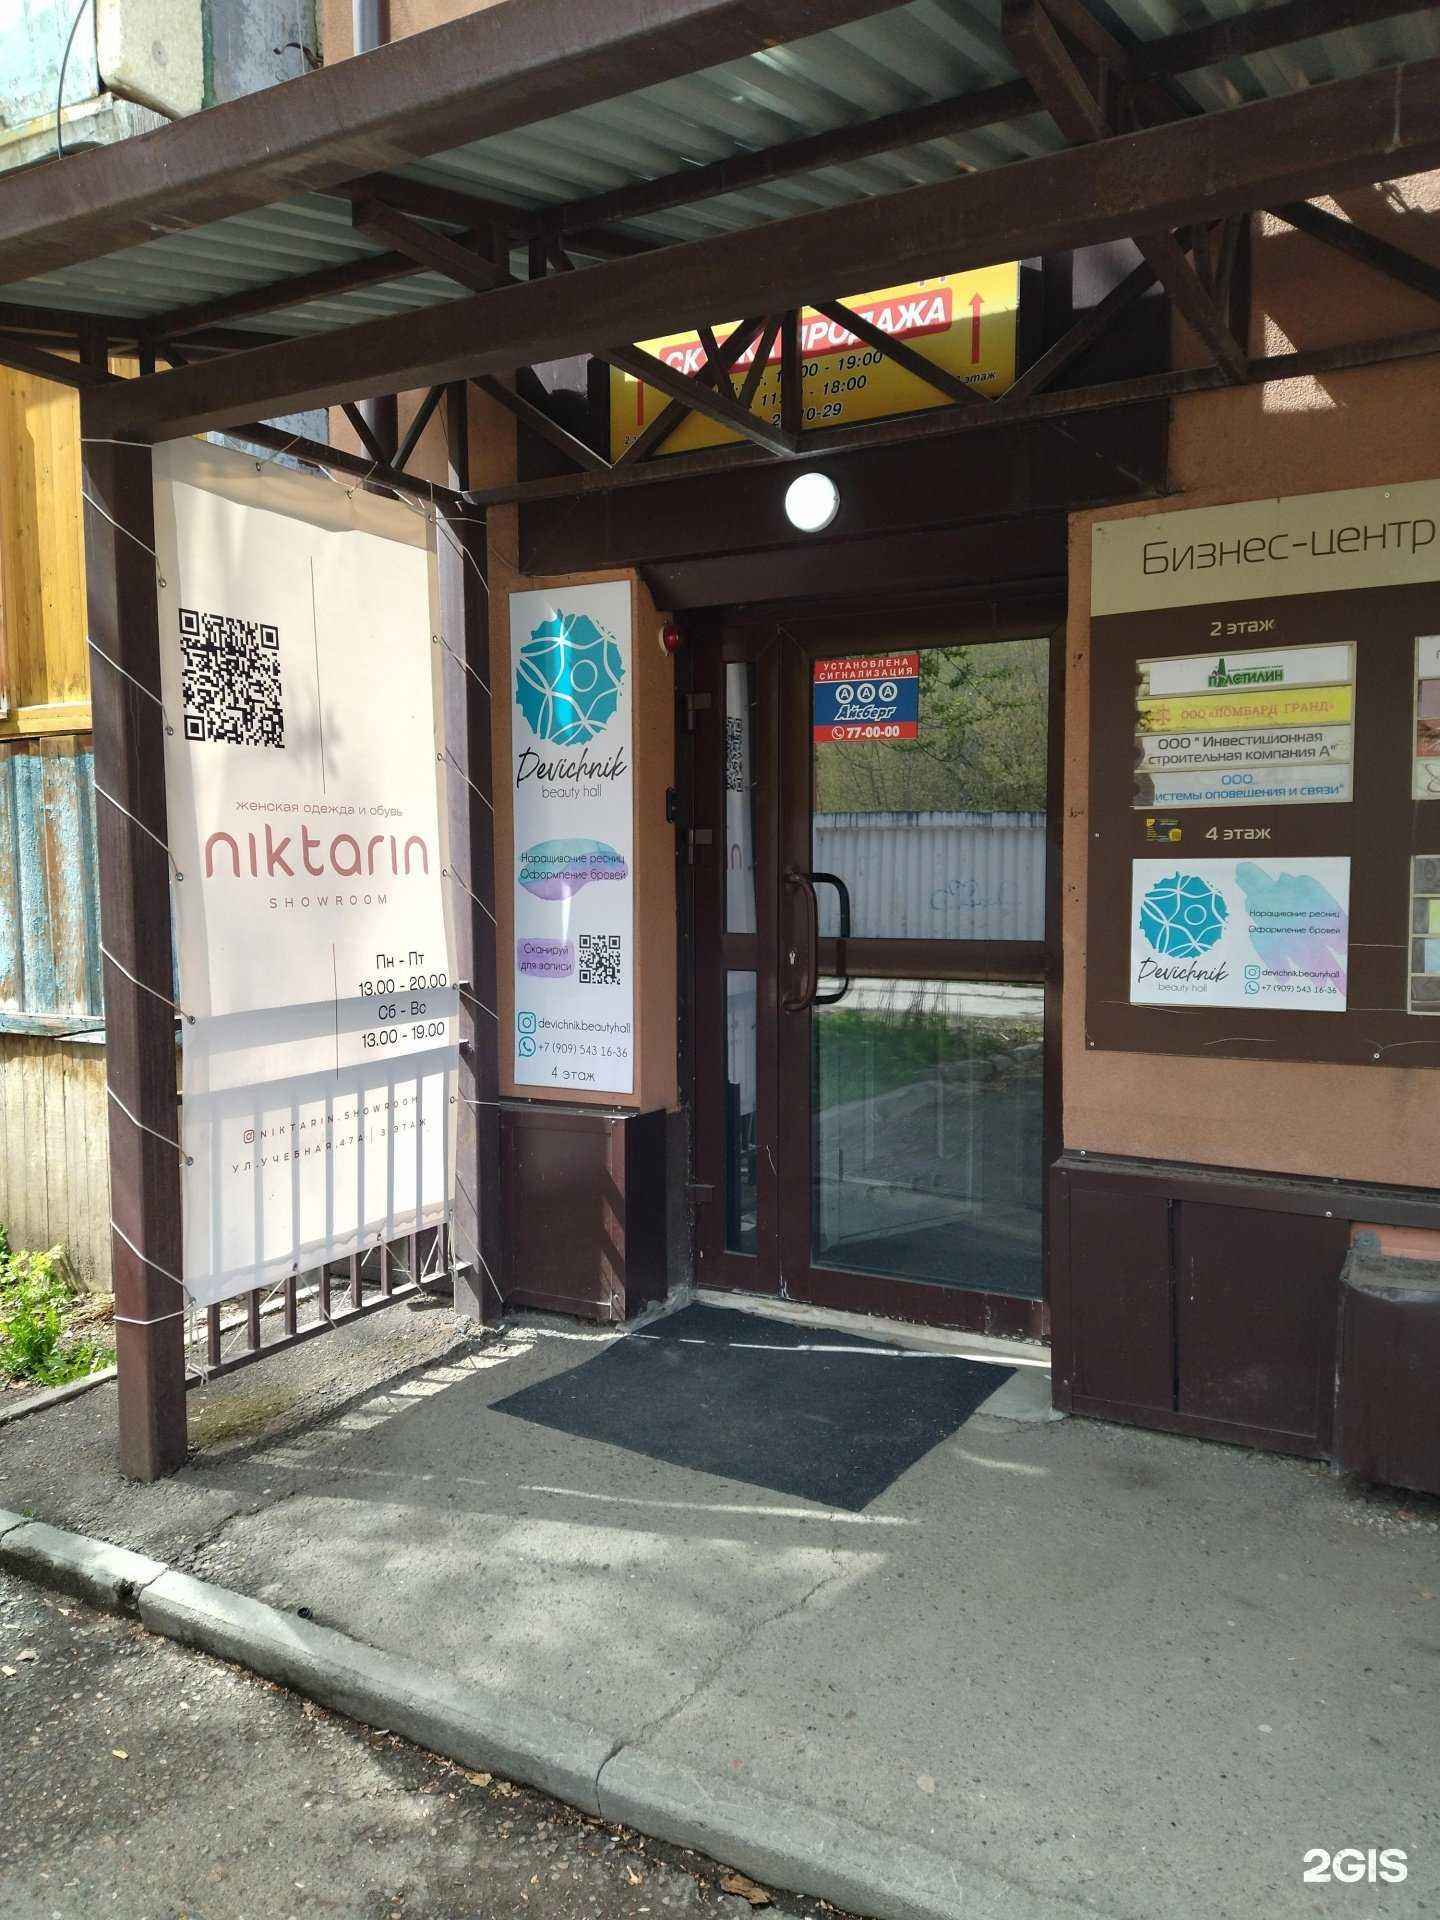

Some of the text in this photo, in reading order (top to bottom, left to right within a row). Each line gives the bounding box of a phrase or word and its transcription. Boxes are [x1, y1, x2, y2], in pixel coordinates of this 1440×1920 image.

[838, 351, 883, 371] 19:00
[823, 376, 867, 395] 18:00
[1143, 518, 1436, 576] Бизнес-центр
[1210, 618, 1275, 637] 2 этаж
[823, 658, 909, 671] УСТАНОВЛЕНА
[819, 667, 913, 680] СИГНАЛИЗАЦИЯ
[834, 704, 897, 722] Айсберг
[846, 725, 900, 739] 77-00-00
[1158, 737, 1191, 751] ООО
[1202, 732, 1323, 747] Инвестиционная
[1149, 751, 1242, 767] строительная
[1243, 747, 1316, 760] компания
[516, 746, 628, 789] Devichnik
[1220, 774, 1253, 786] ООО
[541, 784, 602, 799] beauty hall
[1155, 791, 1202, 802] истемы
[1288, 787, 1298, 796] и
[236, 801, 403, 817] женская одежда и обувь
[1205, 827, 1272, 841] 4 этаж
[205, 823, 429, 878] niktarin
[520, 852, 625, 865] Наращивание ресниц
[520, 868, 627, 881] Оформление бровей
[269, 894, 388, 909] SHOWROOM
[523, 943, 569, 956] Сканируй
[376, 954, 394, 970] Пн
[408, 952, 425, 967] Пт
[520, 962, 572, 972] для записи
[1137, 957, 1229, 984] Devichnik
[358, 978, 395, 998] 13.00
[409, 973, 447, 992] 20.00
[1157, 983, 1208, 993] beauty hall
[1273, 984, 1295, 993] (909)
[1296, 985, 1312, 993] 543
[378, 1004, 396, 1020] Сб
[410, 1000, 427, 1016] Вс
[361, 1028, 398, 1048] 13.00
[412, 1021, 445, 1039] 19.00
[538, 1042, 628, 1058] +7 (909) 543 16-36
[551, 1065, 596, 1082] 4 этаж
